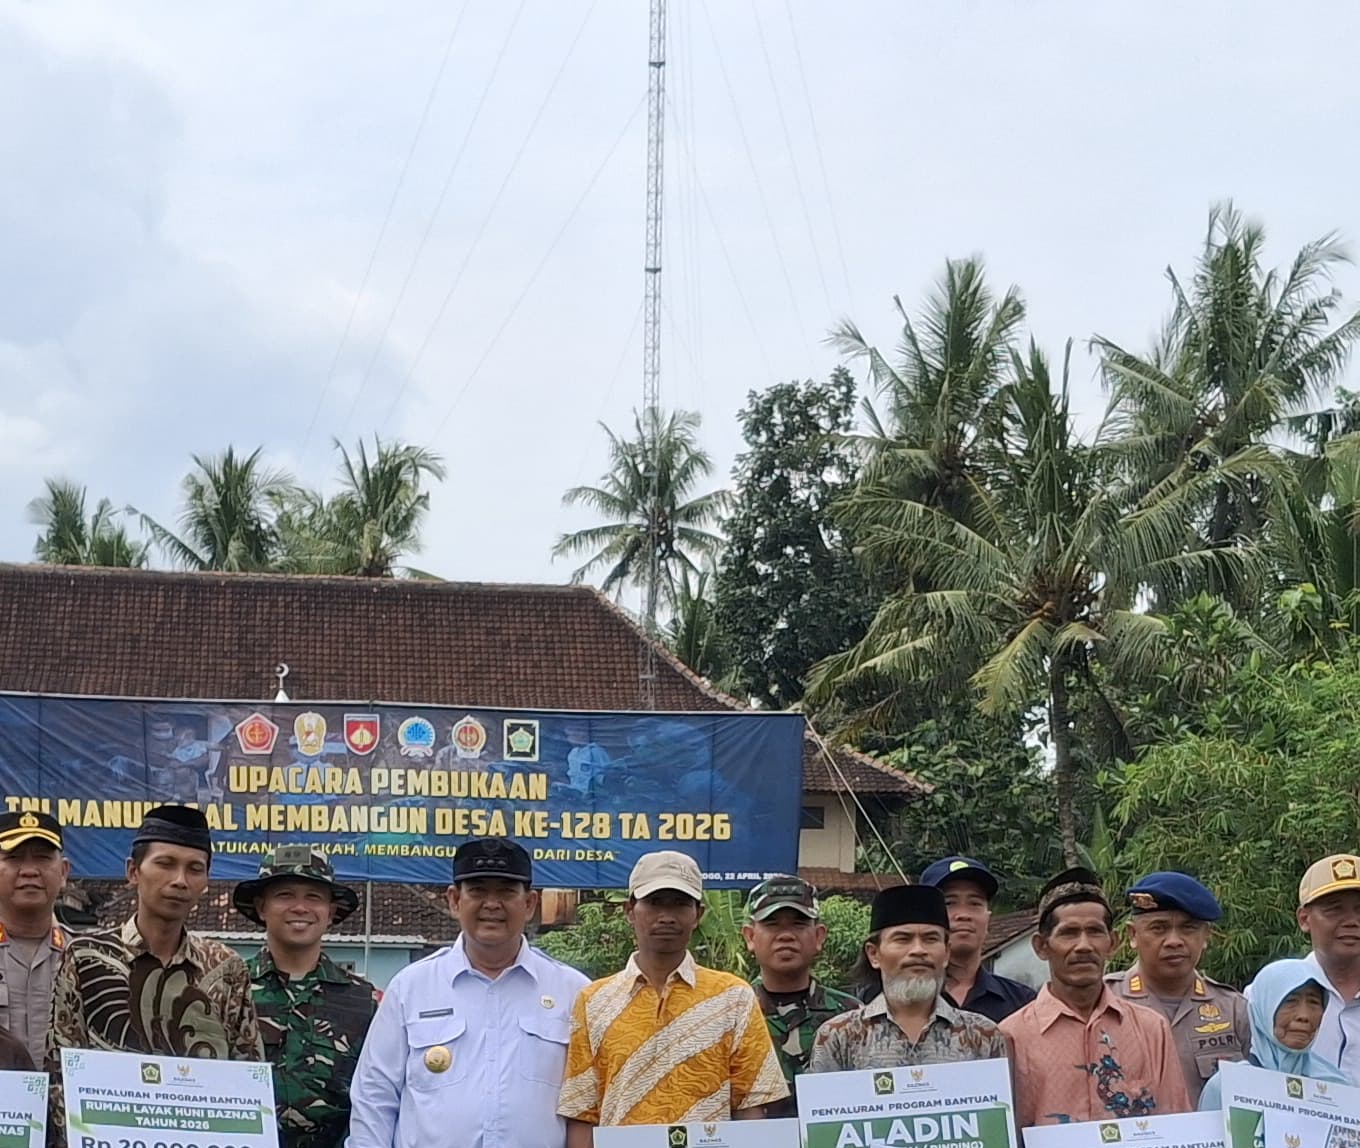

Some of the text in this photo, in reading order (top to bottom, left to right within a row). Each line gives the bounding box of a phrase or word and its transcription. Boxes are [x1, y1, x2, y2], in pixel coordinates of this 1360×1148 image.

[228, 765, 548, 801] UPACARA PEMBUKAAN
[58, 799, 238, 831] MANUAL
[246, 803, 428, 834] MEMBANGUN
[434, 807, 507, 837] DESA
[514, 810, 611, 839] KE-128
[618, 812, 651, 840] TA
[658, 813, 731, 841] 2026
[363, 844, 457, 858] MEMBANGU
[533, 848, 570, 861] DARI
[78, 1086, 262, 1107] PENYALURAN PROGRAM BANTUAN
[811, 1094, 998, 1117] PENYALURAN PROGRAM BANTUAN
[1233, 1094, 1295, 1113] PENYALURAN
[1298, 1107, 1342, 1122] PROGRAM
[85, 1101, 257, 1121] RUMAH LAYAK HUNI BAZNAS
[135, 1116, 210, 1130] TAHUN 2026
[835, 1112, 980, 1148] ALADIN
